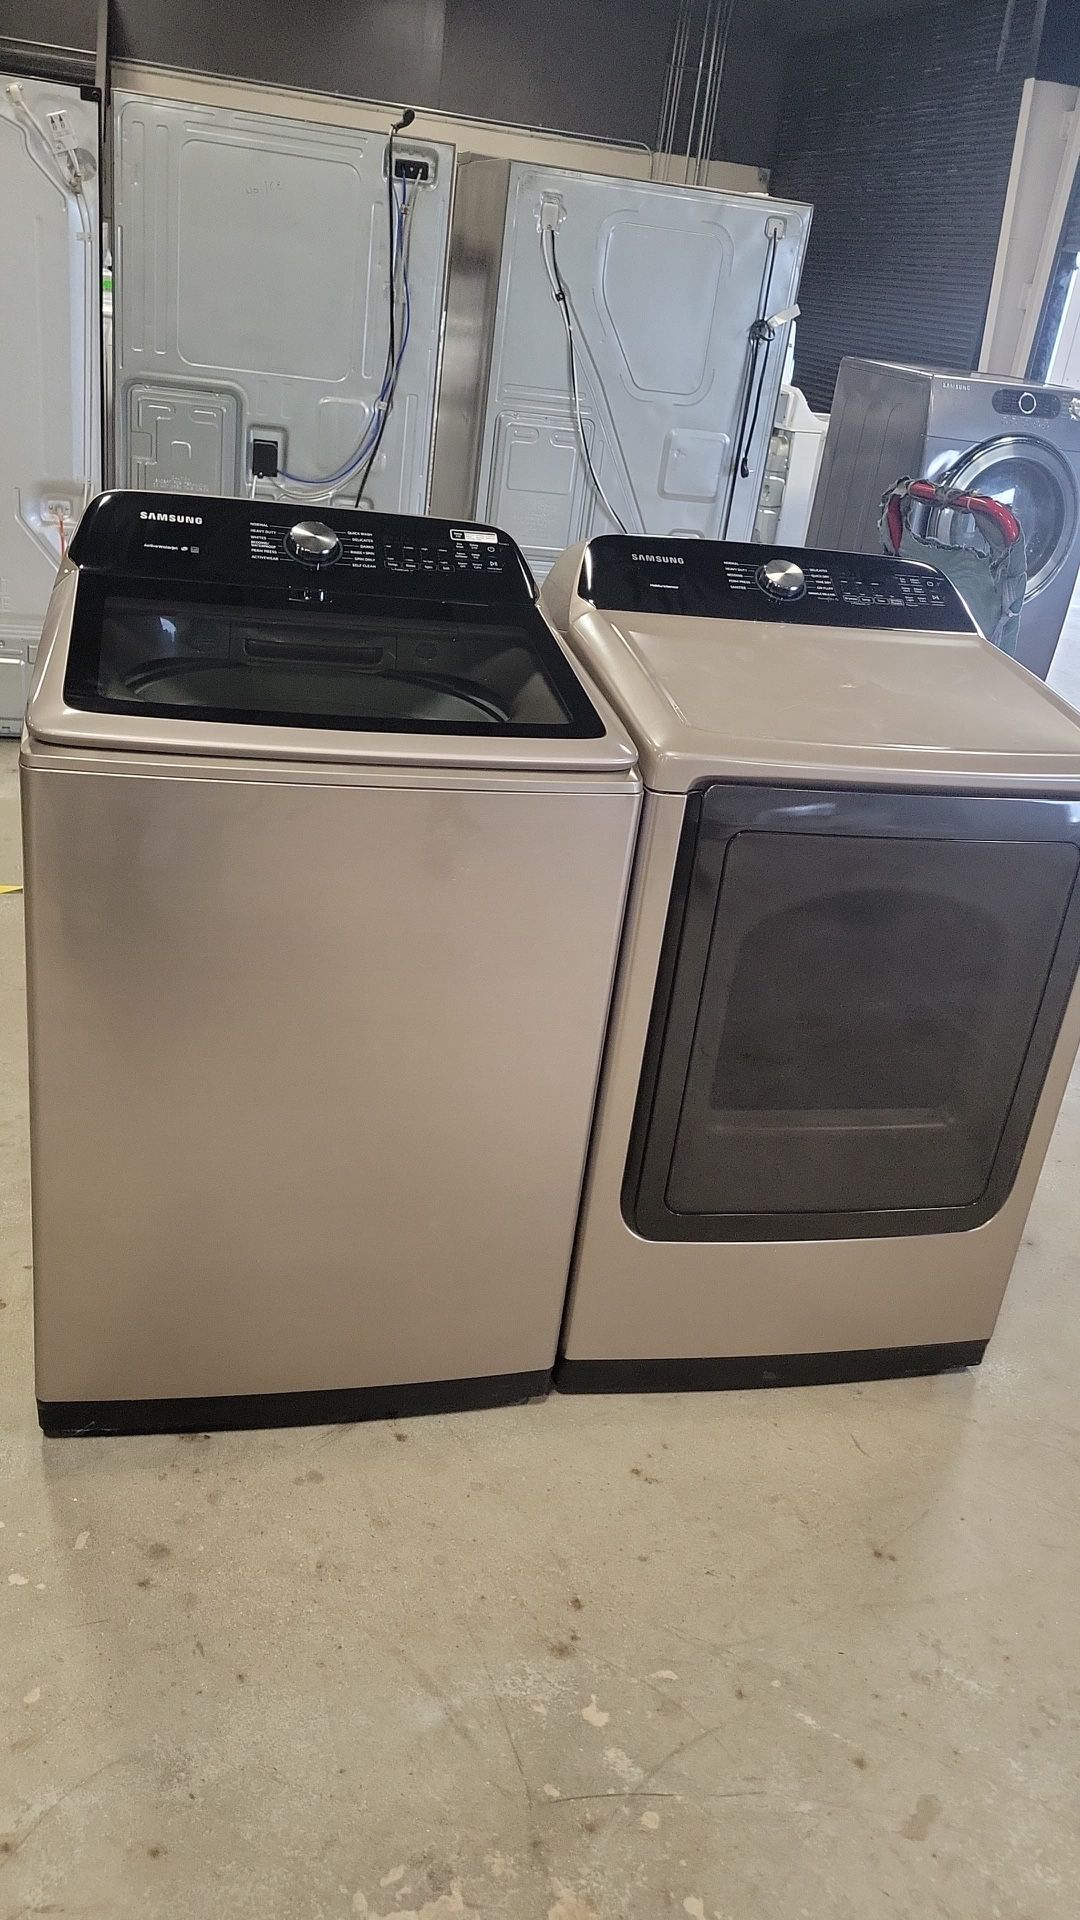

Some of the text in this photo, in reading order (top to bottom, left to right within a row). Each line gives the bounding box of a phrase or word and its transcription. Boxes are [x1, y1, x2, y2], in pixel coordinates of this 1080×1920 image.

[942, 382, 971, 391] SAMSUNG
[140, 511, 203, 525] SAMSUNG
[631, 553, 685, 565] SAMSUNG
